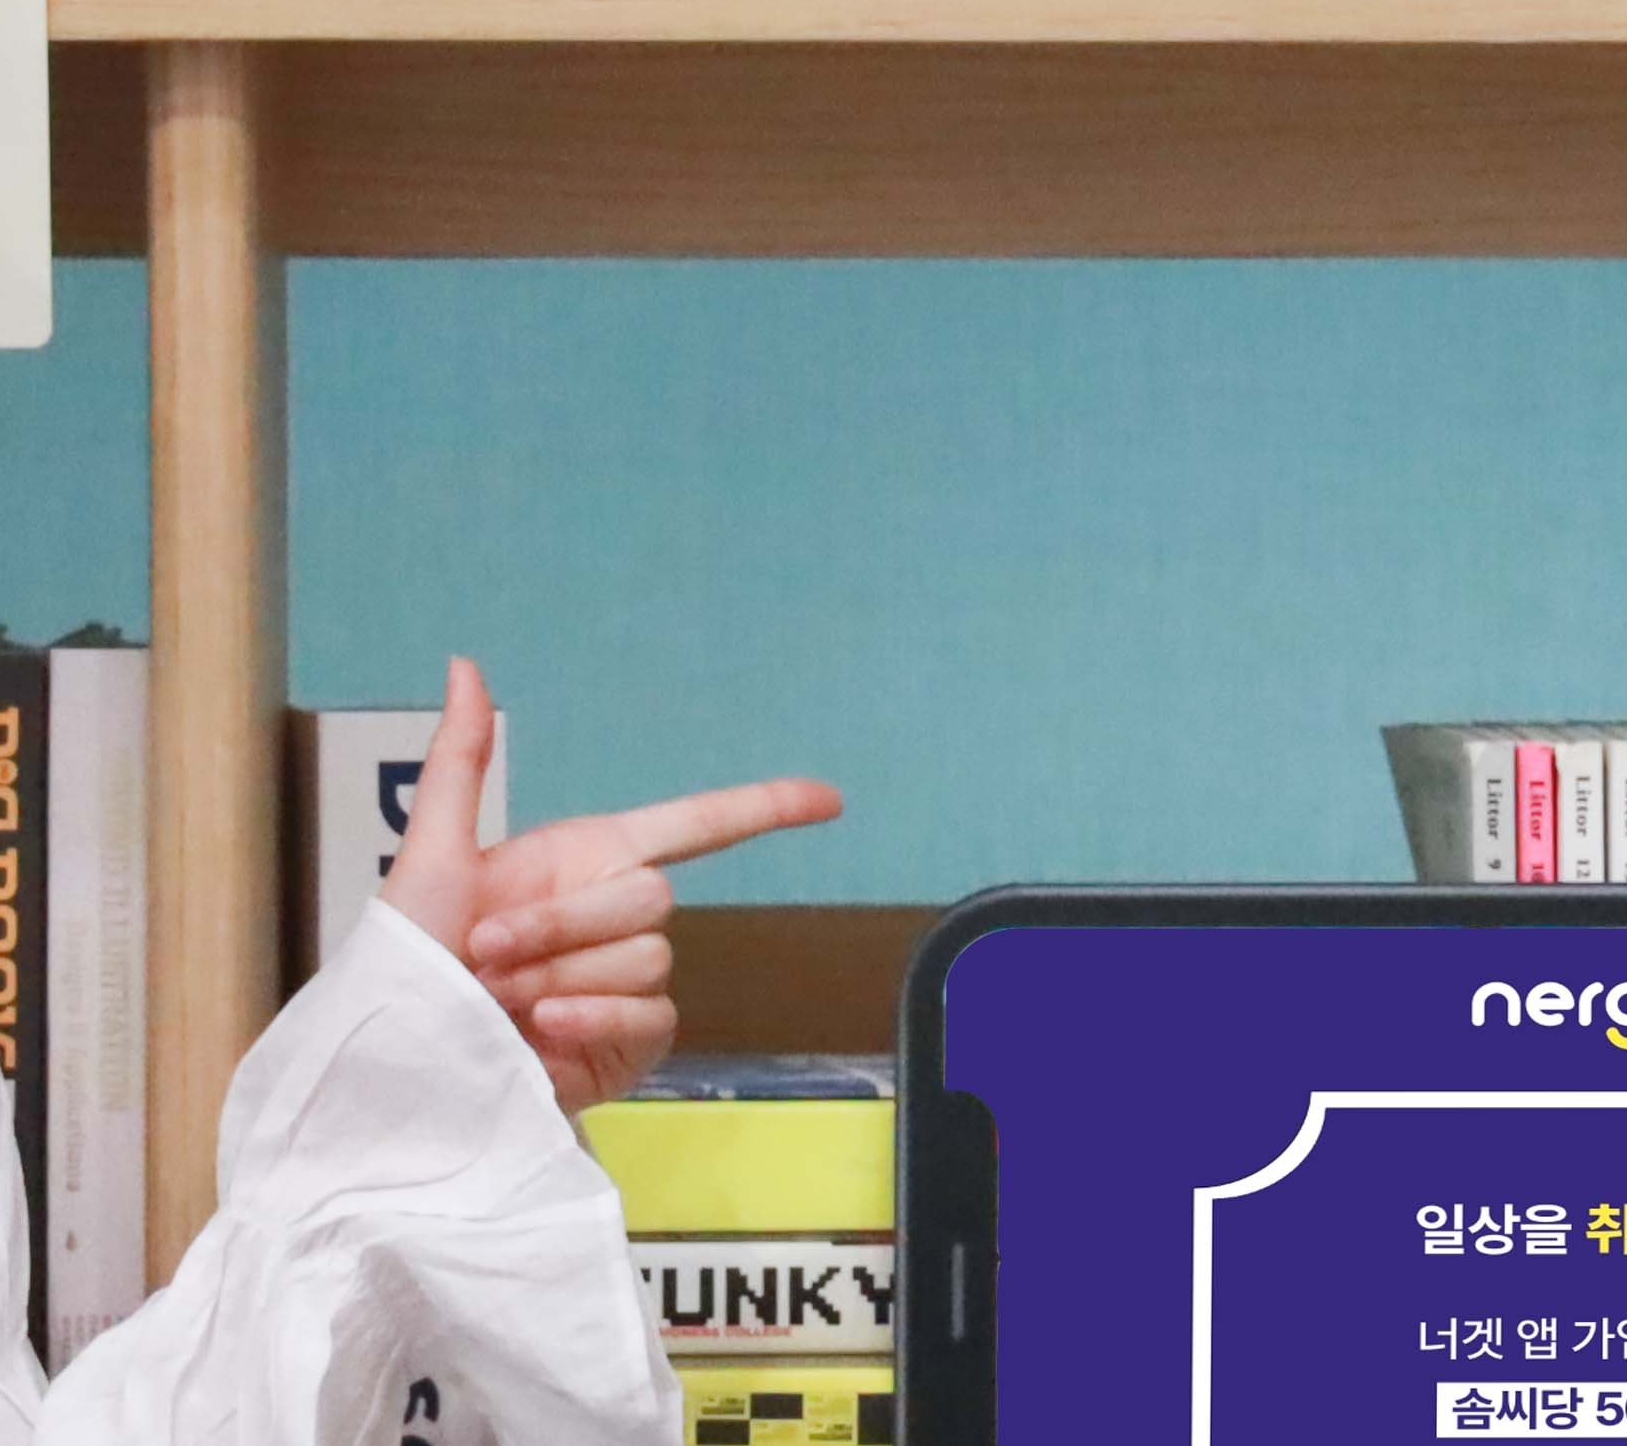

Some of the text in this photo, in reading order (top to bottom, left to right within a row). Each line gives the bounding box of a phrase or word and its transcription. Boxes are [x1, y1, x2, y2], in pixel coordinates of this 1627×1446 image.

[1417, 1204, 1572, 1255] 일상을
[641, 1266, 895, 1326] UNKY
[1420, 1318, 1503, 1360] 너겟
[1517, 1318, 1556, 1359] 앱
[1451, 1384, 1583, 1434] 솜씨당
